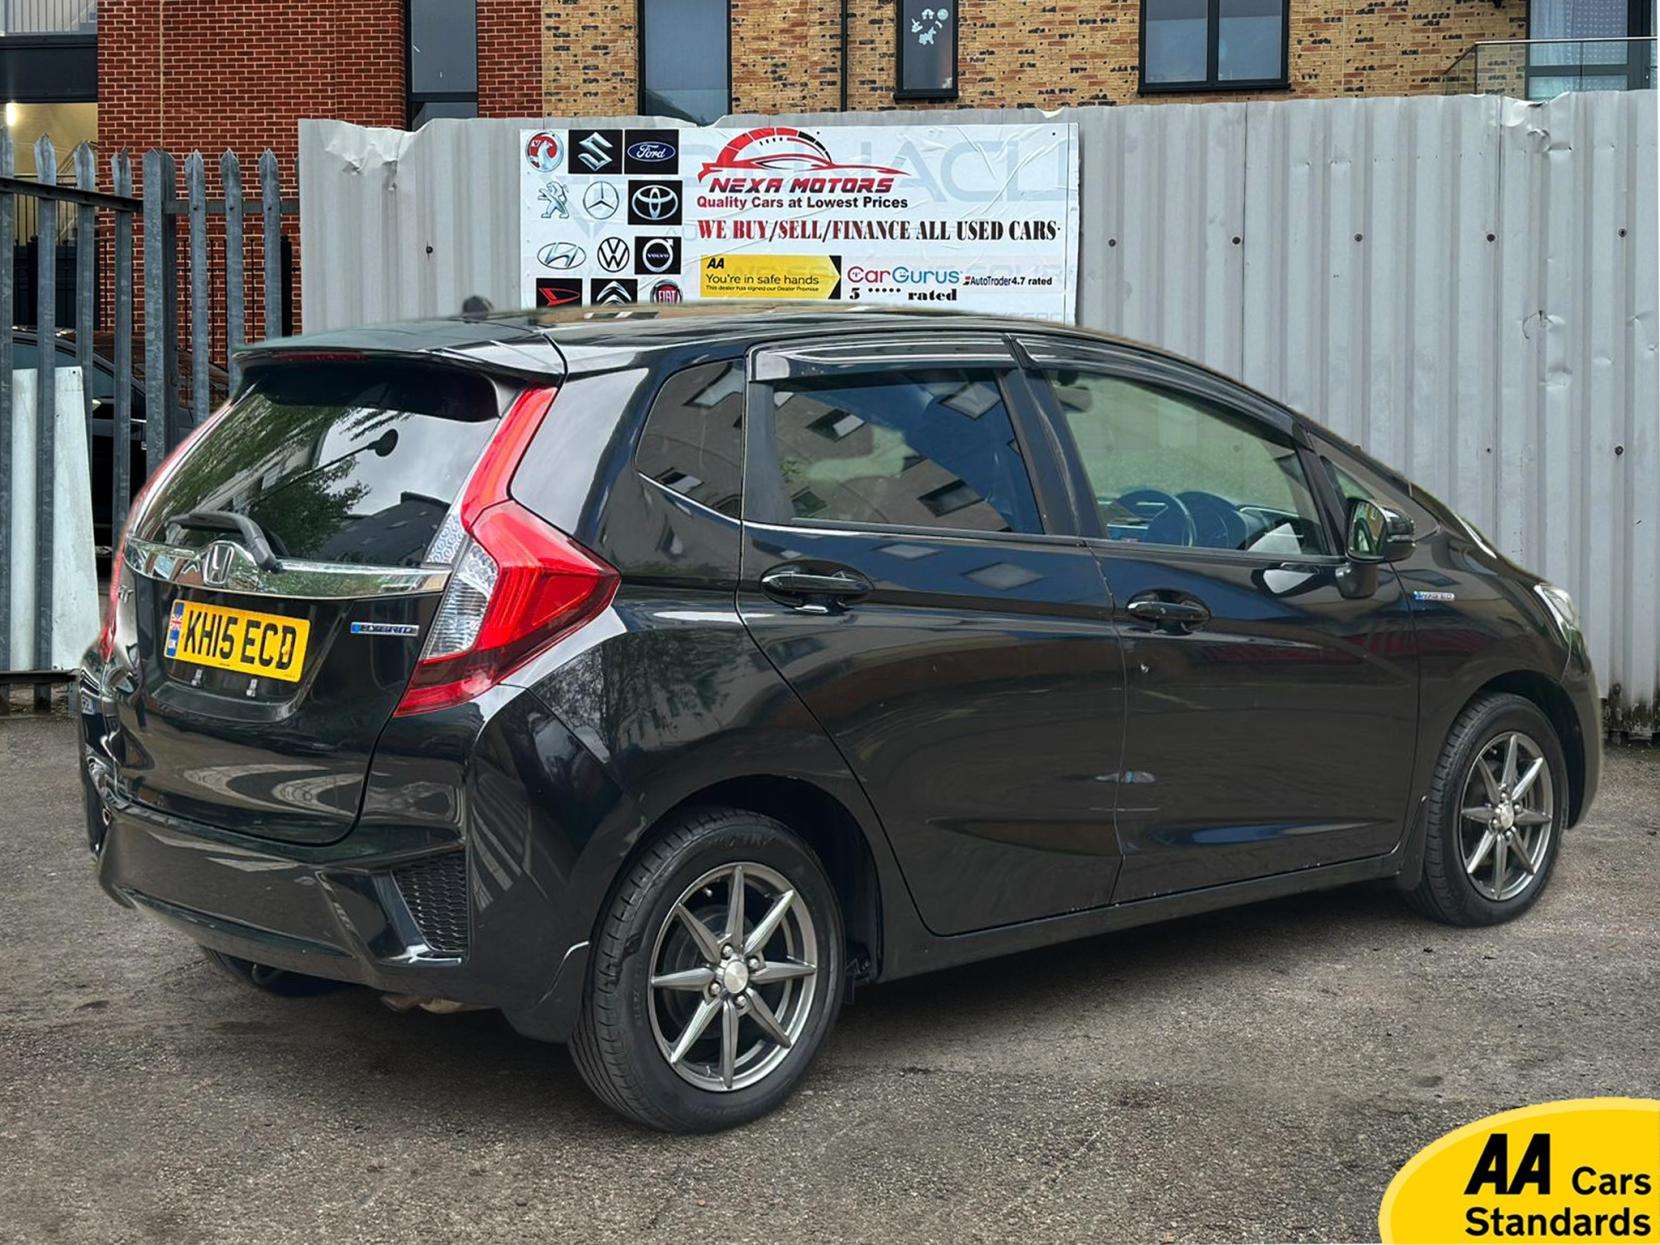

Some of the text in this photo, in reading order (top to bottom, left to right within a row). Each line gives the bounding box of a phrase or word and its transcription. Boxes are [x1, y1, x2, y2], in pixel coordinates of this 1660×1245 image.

[636, 145, 666, 159] Ford
[709, 178, 894, 193] NEXA MOTORS
[697, 196, 908, 210] Quality Cars at Lowest Prices
[698, 220, 727, 239] WE
[733, 220, 911, 242] BUY/SELL/FINANCE
[916, 220, 951, 240] ALL
[956, 220, 1004, 240] USED
[1008, 220, 1057, 240] CARS
[707, 258, 725, 269] AA
[706, 273, 819, 285] You're in safe hands
[847, 266, 960, 284] CarGurus
[1028, 277, 1052, 285] rated
[658, 290, 677, 304] FIAT
[849, 288, 957, 301] 5 rated
[183, 609, 297, 671] KH15 ECD
